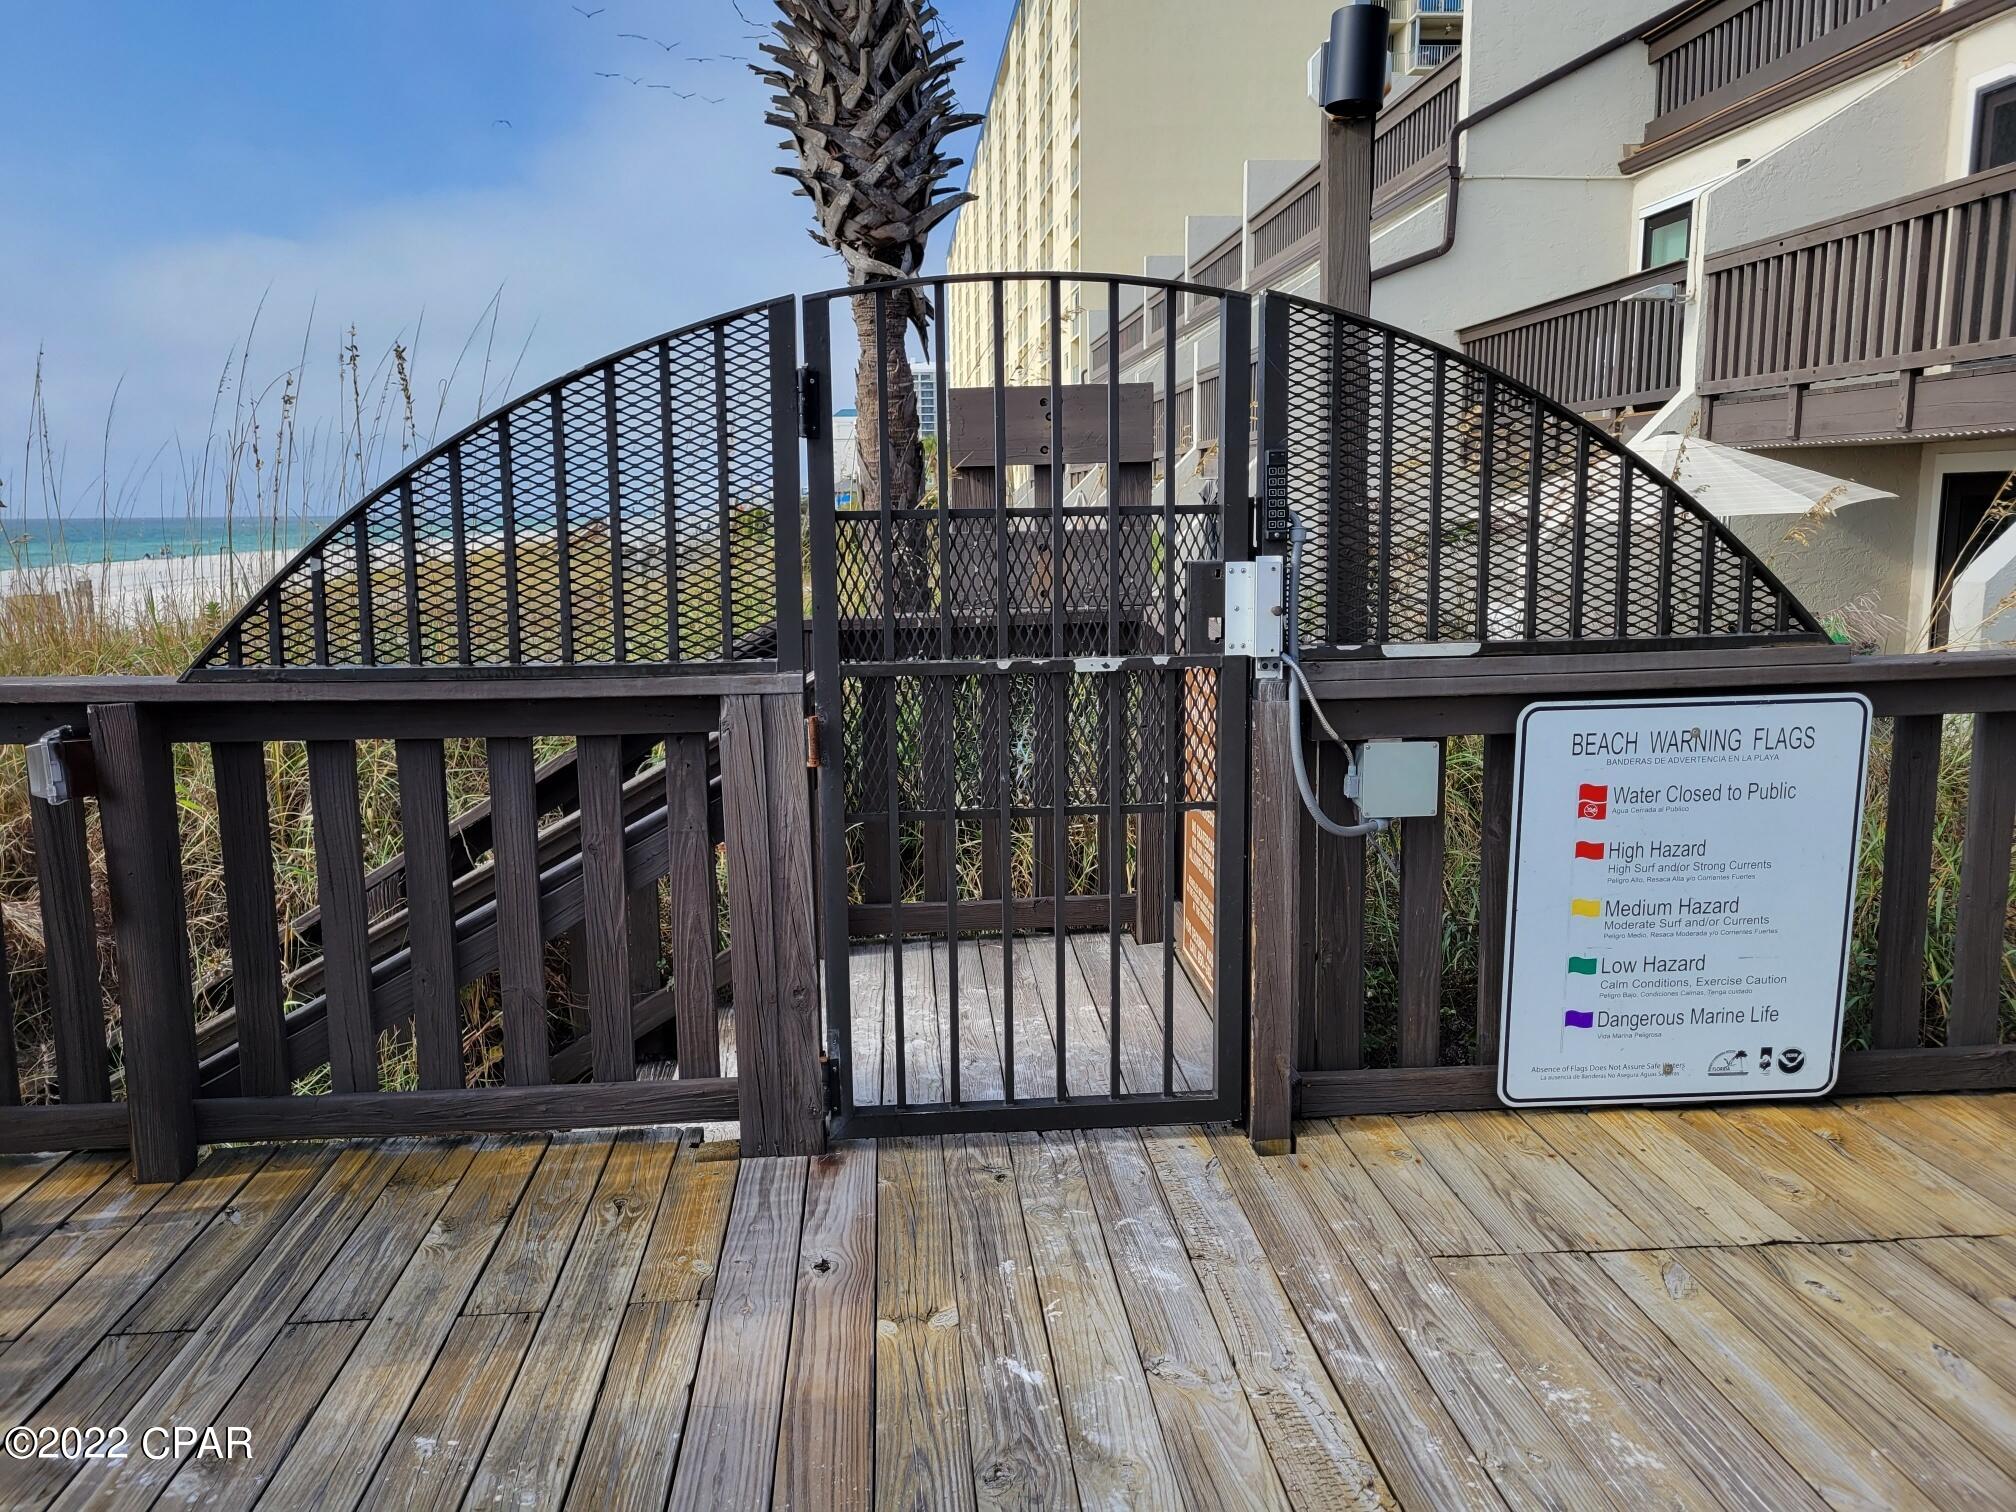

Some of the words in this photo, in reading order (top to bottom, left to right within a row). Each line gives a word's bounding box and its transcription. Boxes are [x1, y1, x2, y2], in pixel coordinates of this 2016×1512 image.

[1571, 731, 1638, 756] BEACH
[1650, 728, 1742, 754] WARNING
[1753, 726, 1816, 750] FLAGS
[1606, 757, 1652, 766] BANDERAS
[1654, 756, 1666, 765] DE
[1667, 755, 1727, 764] ADVERTENCIA
[1741, 754, 1752, 762] LA
[1753, 753, 1780, 761] PLAYA
[1613, 786, 1661, 804] Water
[1666, 784, 1722, 803] Closed
[1727, 784, 1742, 801] to
[1747, 781, 1797, 800] Public
[1611, 807, 1628, 815] Agua
[1608, 841, 1644, 863] High
[1650, 839, 1707, 858] Hazard
[1608, 864, 1631, 875] High
[1634, 862, 1656, 873] Surf
[1657, 862, 1690, 872] and/or
[1693, 861, 1726, 873] Strong
[1729, 860, 1772, 870] Currents
[1607, 877, 1630, 885] Peligro
[1605, 899, 1672, 917] Medium
[1678, 896, 1740, 915] Hazard
[1604, 920, 1656, 930] Moderate
[1659, 918, 1682, 928] Surf
[1684, 917, 1720, 927] and/or
[1723, 915, 1770, 926] Currents
[1601, 957, 1637, 974] Low
[1643, 954, 1706, 972] Hazard
[1600, 980, 1628, 990] Calm
[1632, 978, 1692, 989] Conditions,
[1696, 976, 1743, 987] Exercise
[1745, 975, 1787, 985] Caution
[1597, 1011, 1685, 1031] Dangerous
[1690, 1007, 1745, 1025] Marine
[1750, 1005, 1779, 1023] Life
[1570, 1065, 1588, 1073] Flags
